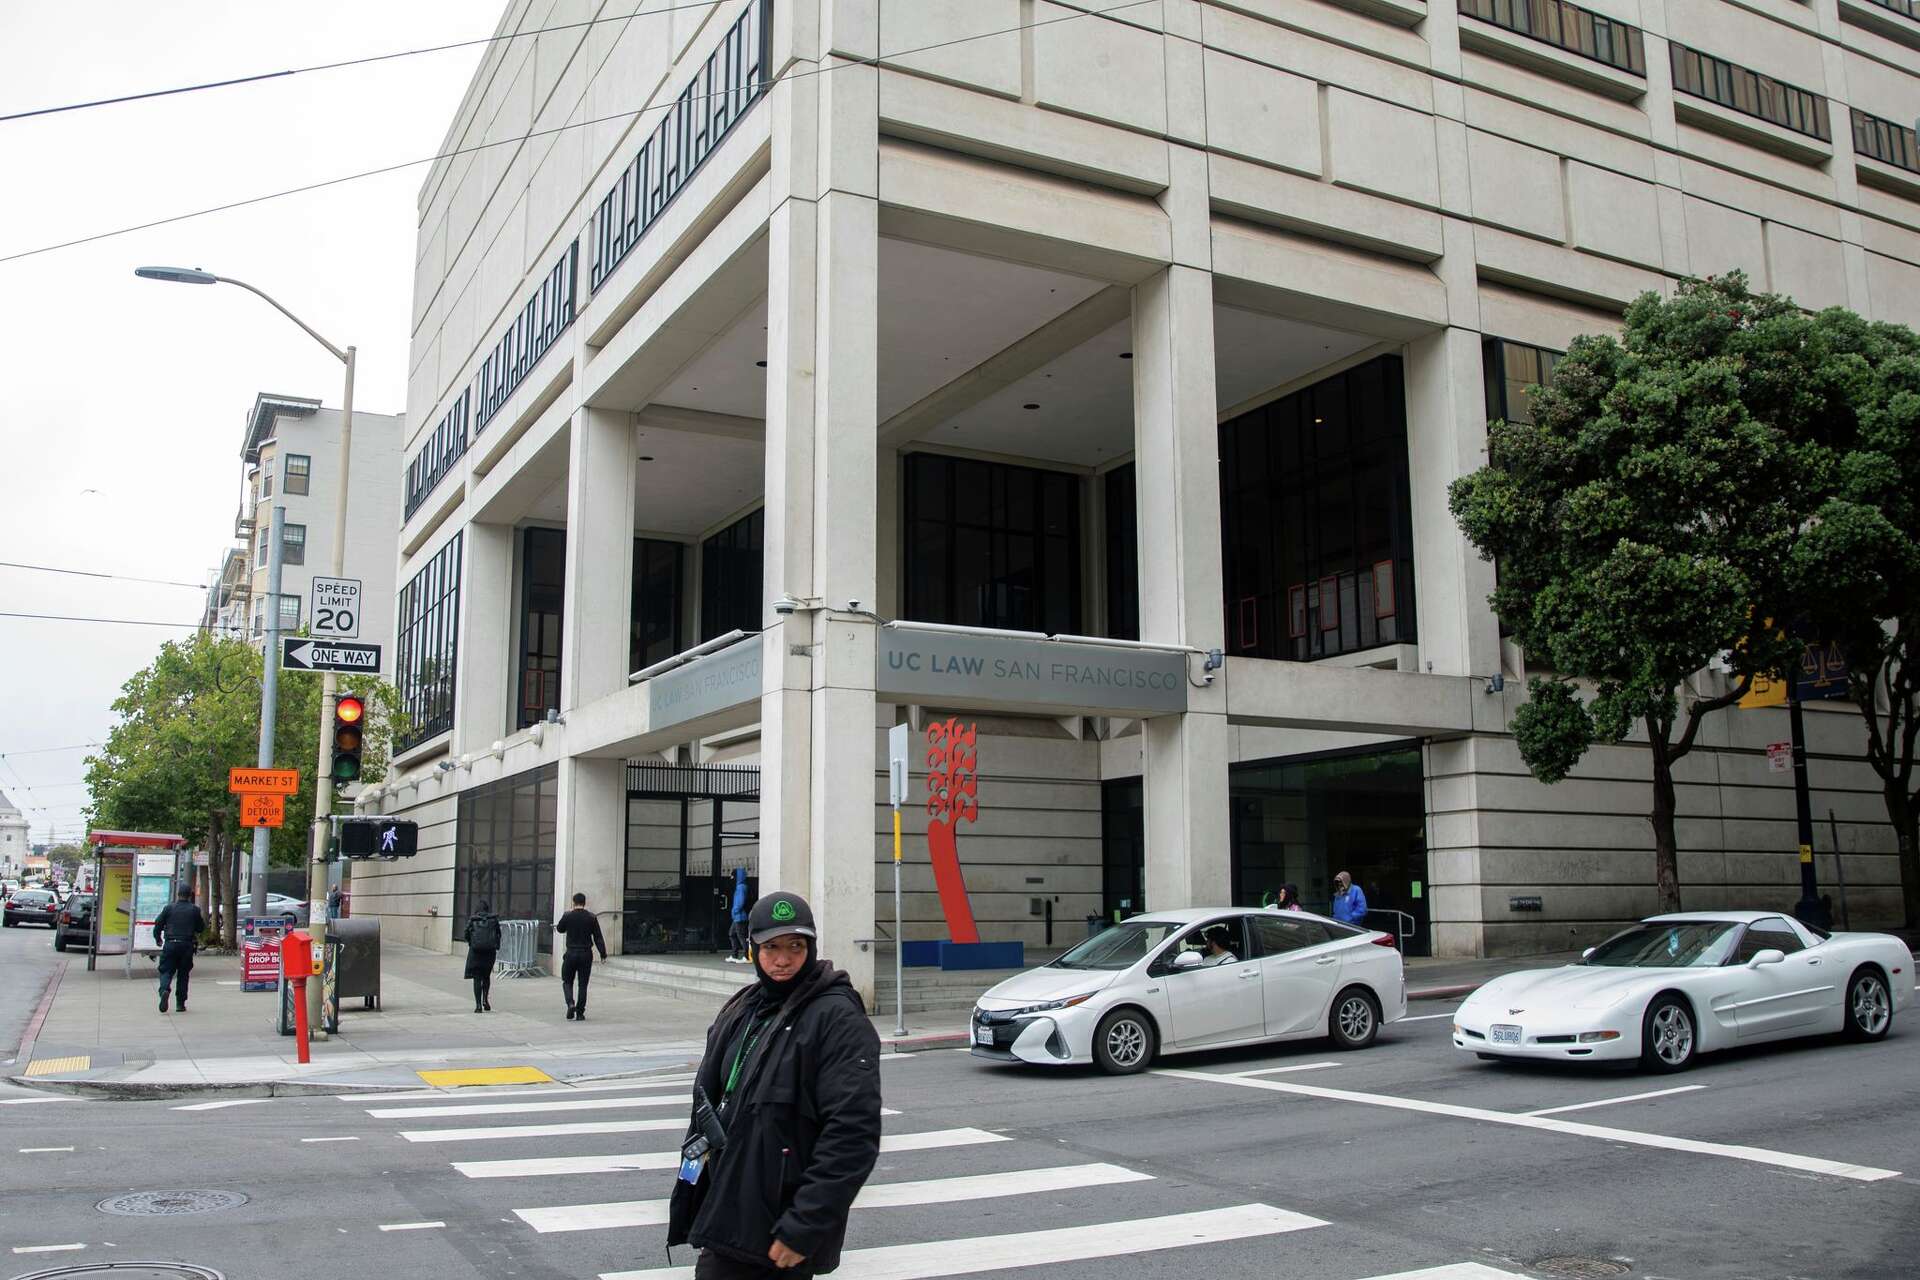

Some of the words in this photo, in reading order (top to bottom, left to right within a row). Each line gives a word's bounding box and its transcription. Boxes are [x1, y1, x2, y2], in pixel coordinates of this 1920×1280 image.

[316, 583, 357, 595] SPEED
[320, 596, 352, 607] LIMIT
[316, 608, 354, 632] 20
[311, 649, 339, 663] ONE
[344, 651, 373, 665] WAY
[889, 650, 921, 671] UC
[931, 654, 985, 676] LAW
[994, 659, 1041, 681] SAN
[1051, 663, 1177, 690] FRANCISCO
[234, 775, 279, 786] MARKET
[280, 776, 293, 787] ST
[247, 807, 280, 817] DETOUR
[249, 956, 270, 964] DROP
